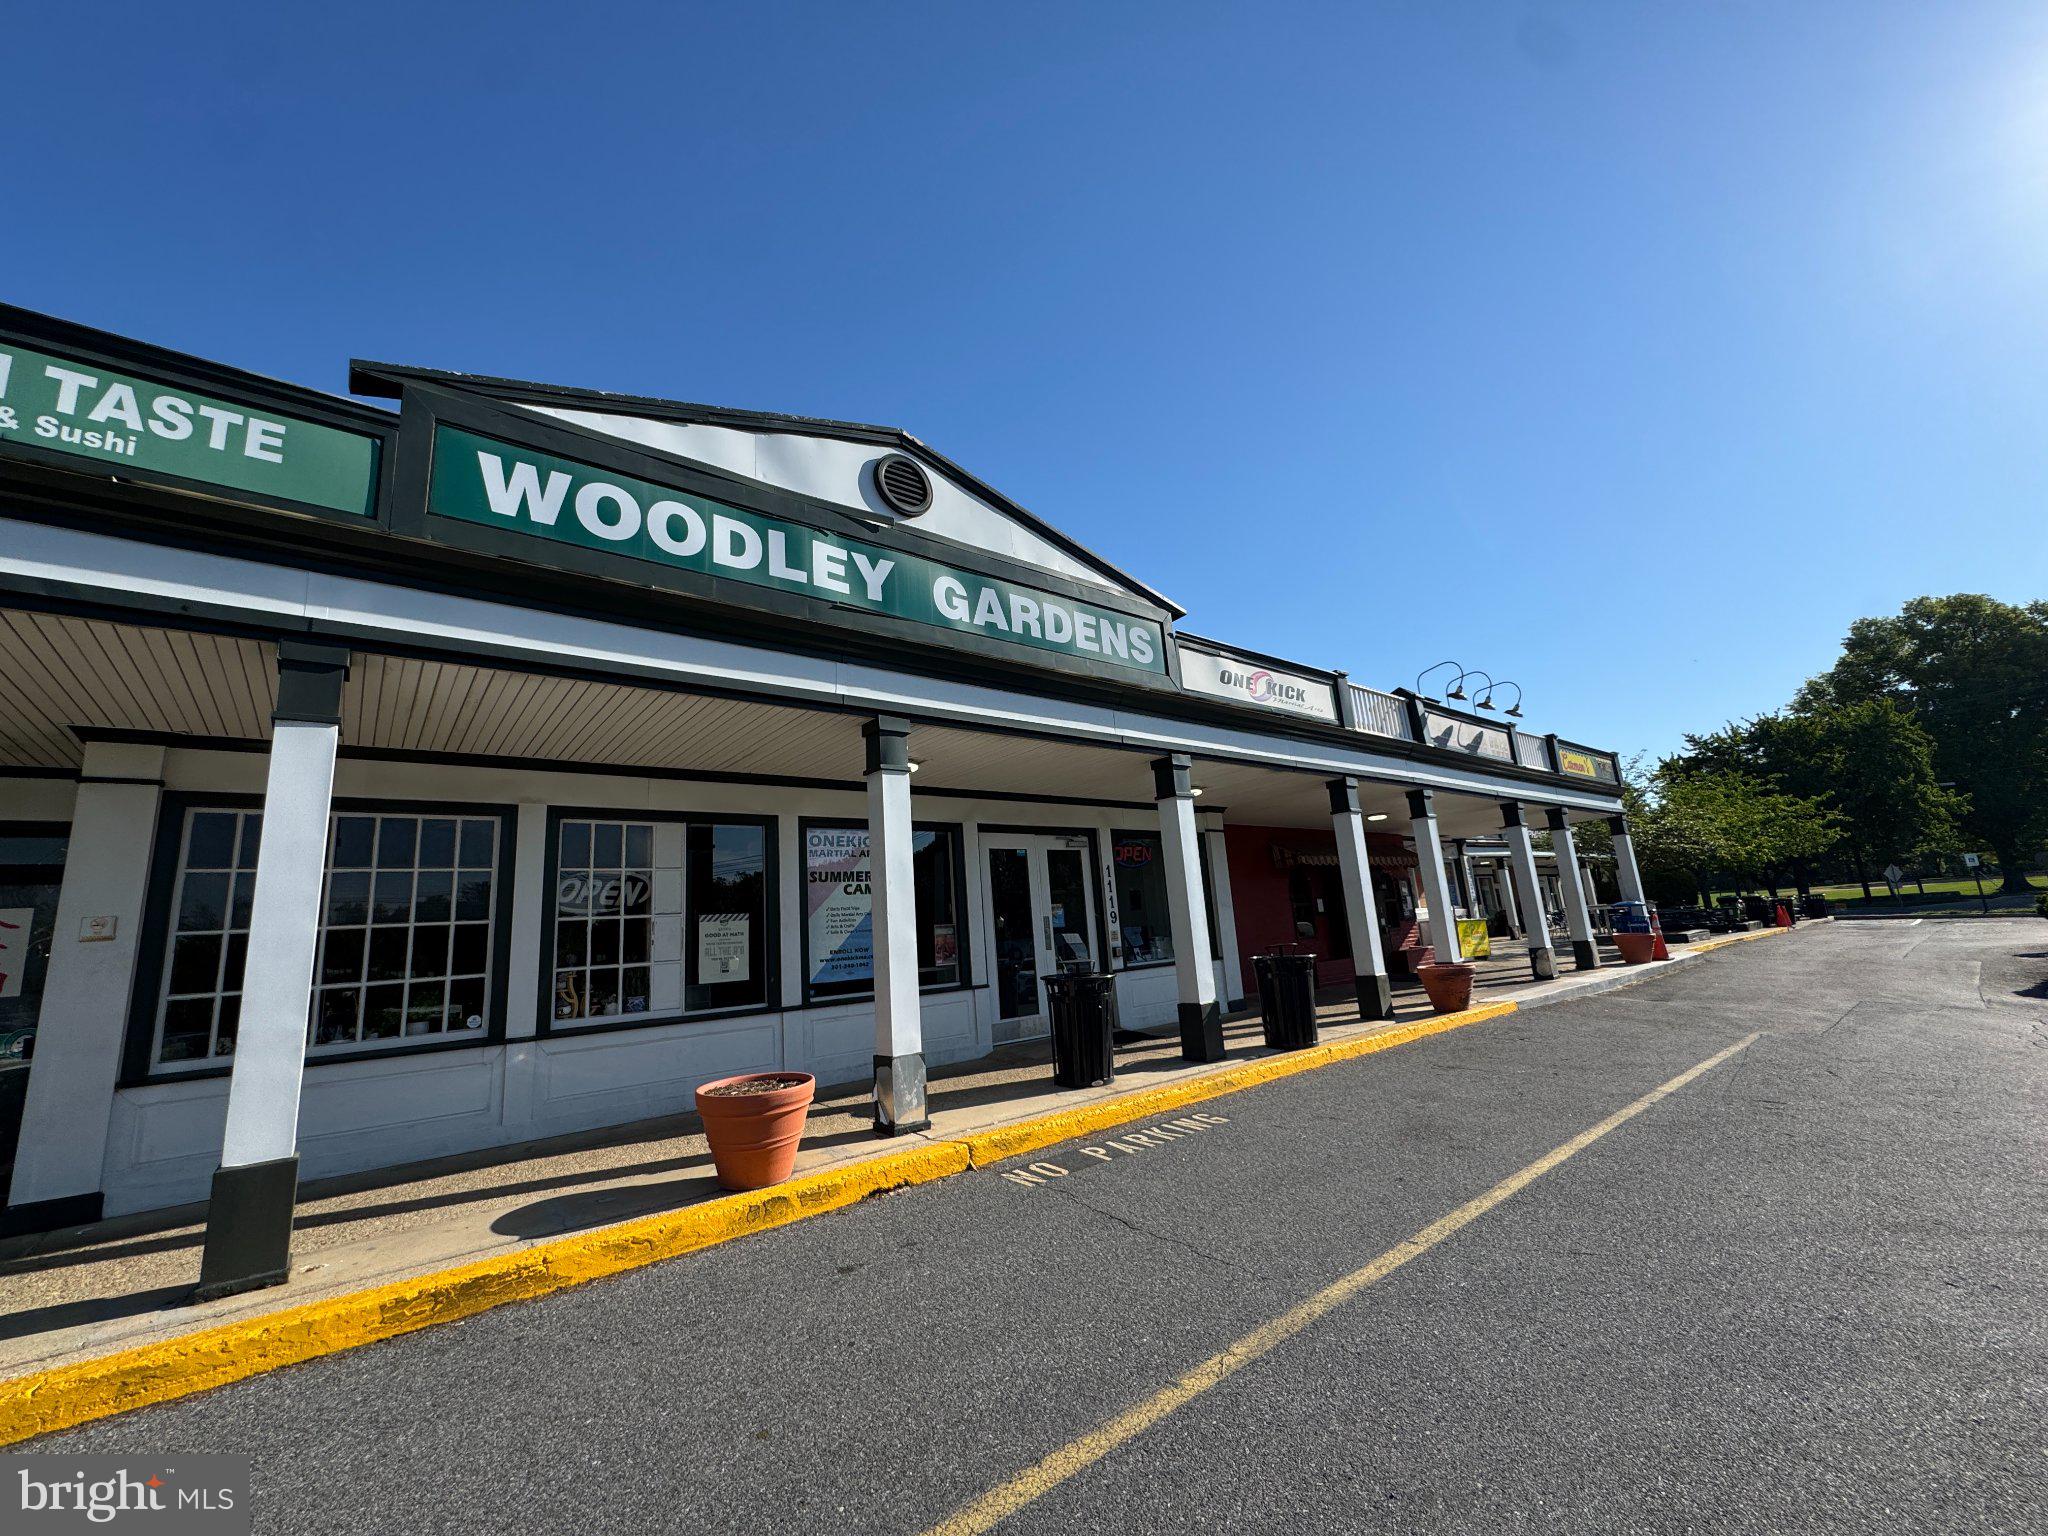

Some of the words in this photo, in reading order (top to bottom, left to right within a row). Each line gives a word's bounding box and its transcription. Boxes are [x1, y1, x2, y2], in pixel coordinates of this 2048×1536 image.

[44, 365, 287, 464] TASTE
[34, 415, 138, 457] Sushi
[476, 450, 896, 602] WOODLEY
[933, 575, 1155, 666] GARDENS
[1219, 669, 1255, 691] ONE
[1266, 680, 1306, 703] KICK
[808, 834, 870, 848] ONEKIC
[808, 849, 857, 858] MARTIAL
[859, 849, 870, 858] A
[1113, 846, 1153, 862] OPEN
[809, 870, 872, 883] SUMMER
[843, 883, 872, 896] CA
[560, 878, 644, 907] OPEN
[1105, 864, 1117, 924] 1119
[1001, 1162, 1069, 1188] NO
[1079, 1113, 1231, 1162] PARKING
